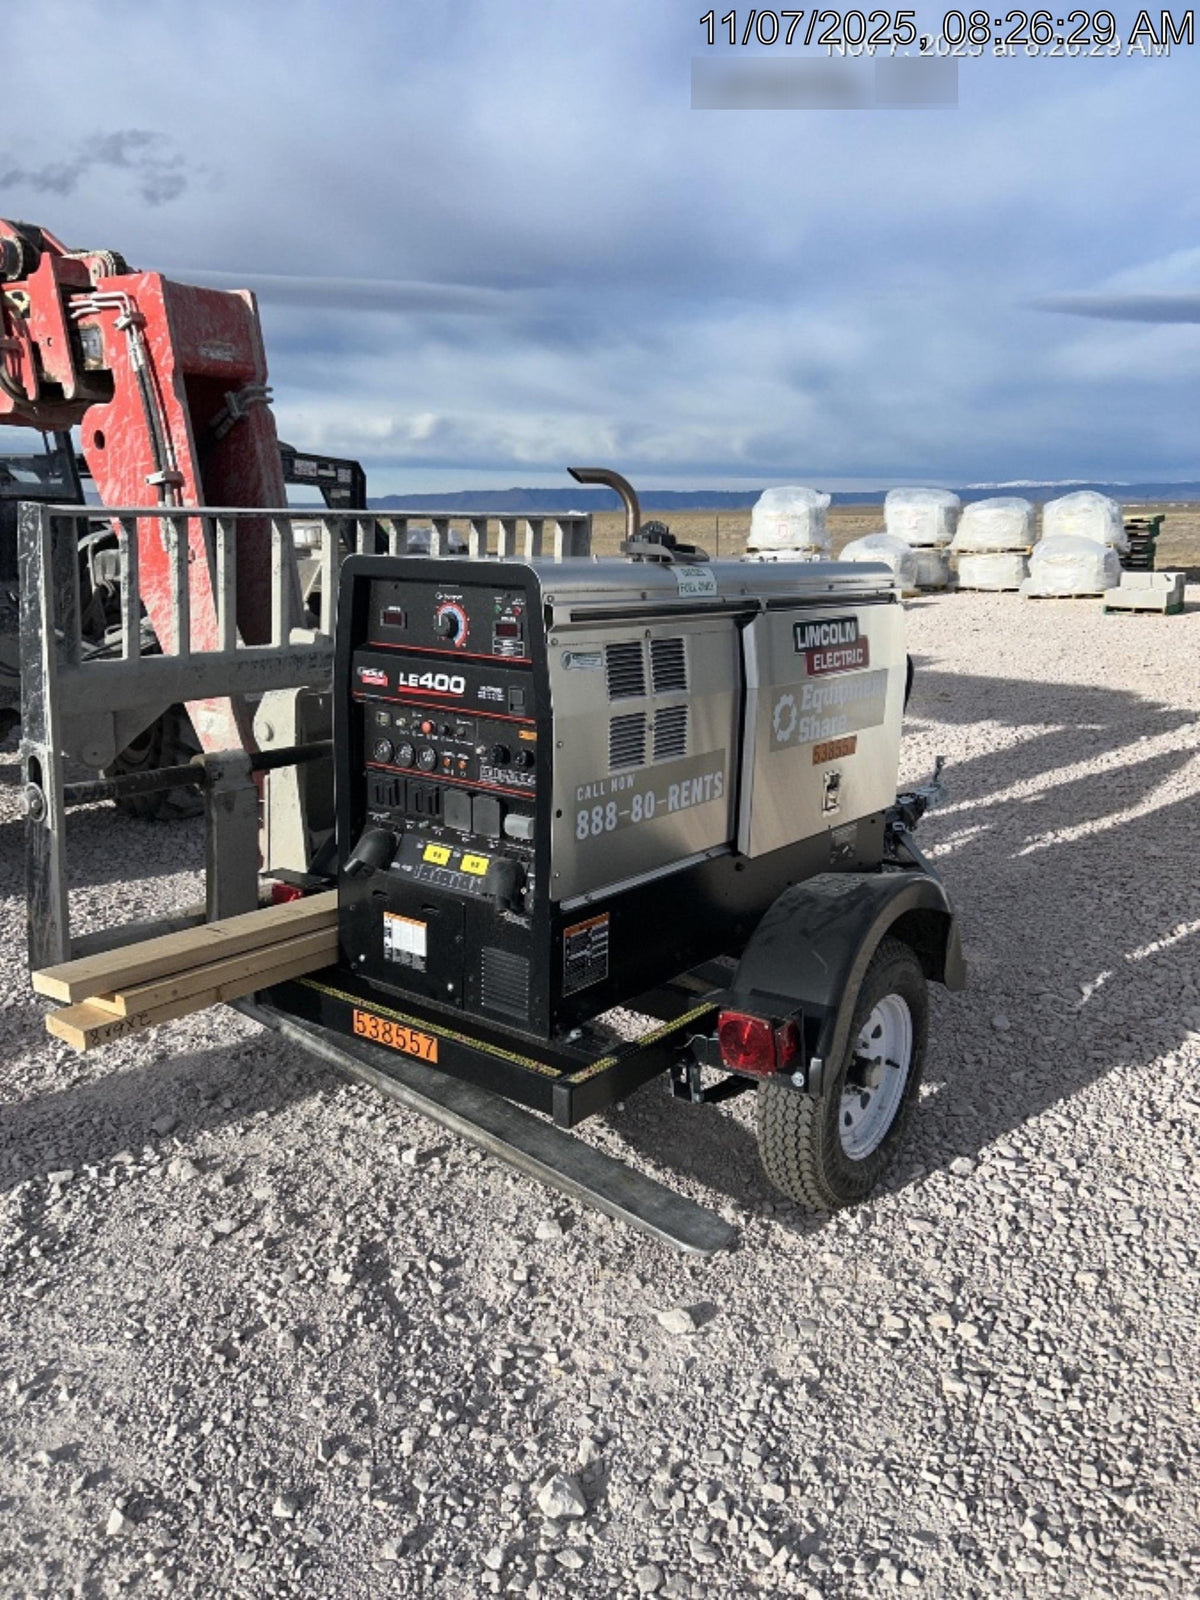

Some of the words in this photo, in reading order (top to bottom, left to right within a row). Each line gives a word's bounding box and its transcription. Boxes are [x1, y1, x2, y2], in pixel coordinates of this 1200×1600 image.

[796, 621, 857, 650] LINCOLN
[813, 648, 864, 671] ELECTRIC
[398, 671, 466, 695] LE400
[799, 713, 848, 743] Share
[577, 782, 606, 801] CALL
[611, 773, 637, 793] NOW
[576, 770, 724, 840] 888-80-RENTS
[355, 1009, 435, 1059] 538557
